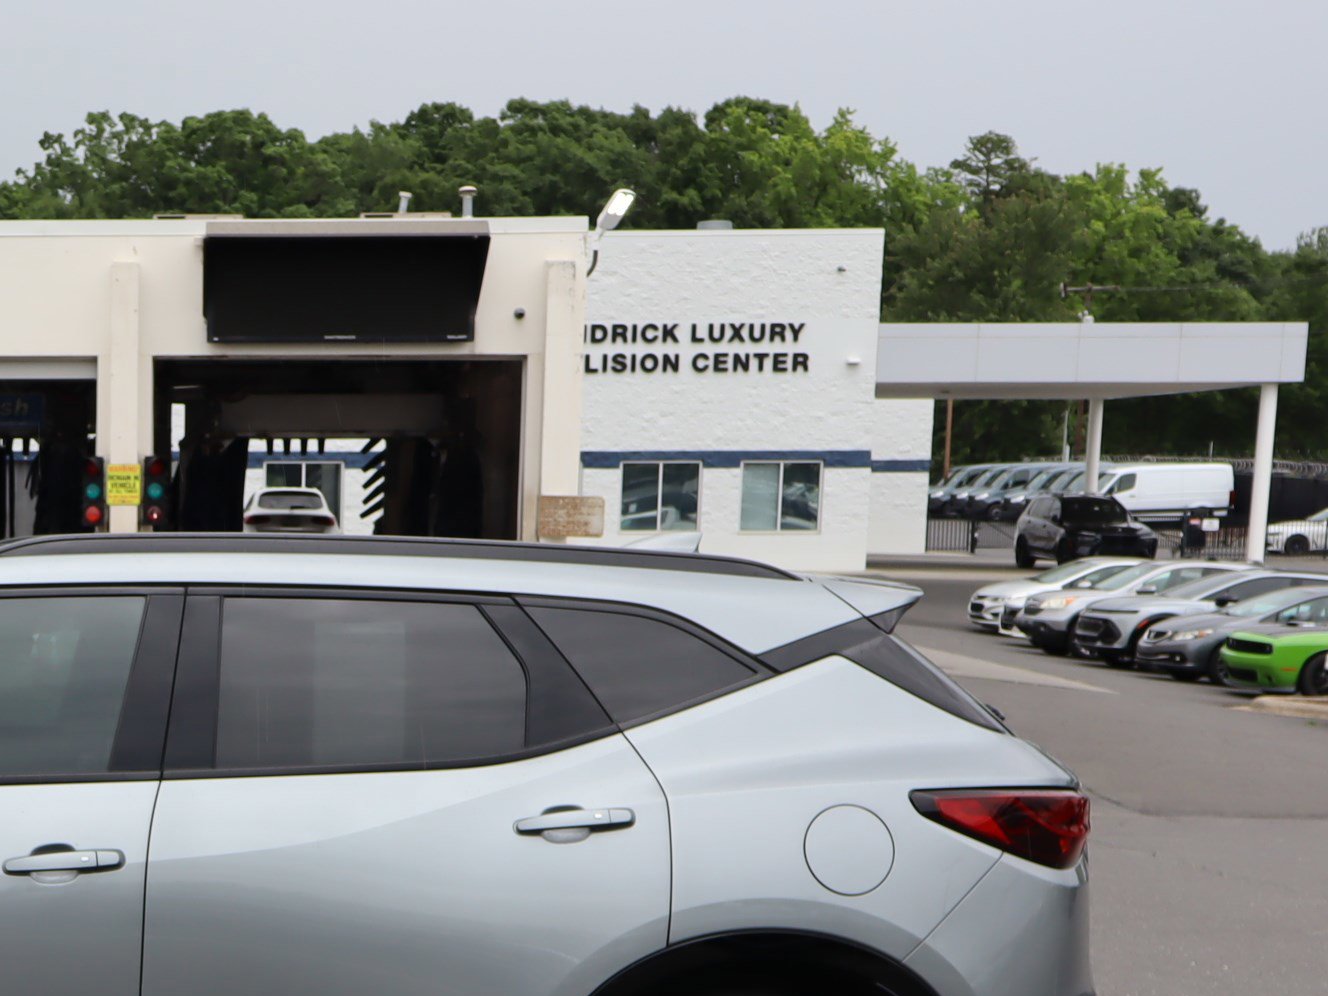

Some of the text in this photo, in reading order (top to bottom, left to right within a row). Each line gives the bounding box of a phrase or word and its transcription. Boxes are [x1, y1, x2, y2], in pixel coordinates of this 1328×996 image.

[583, 323, 806, 343] DRICK LUXURY
[583, 353, 810, 373] LISION CENTER
